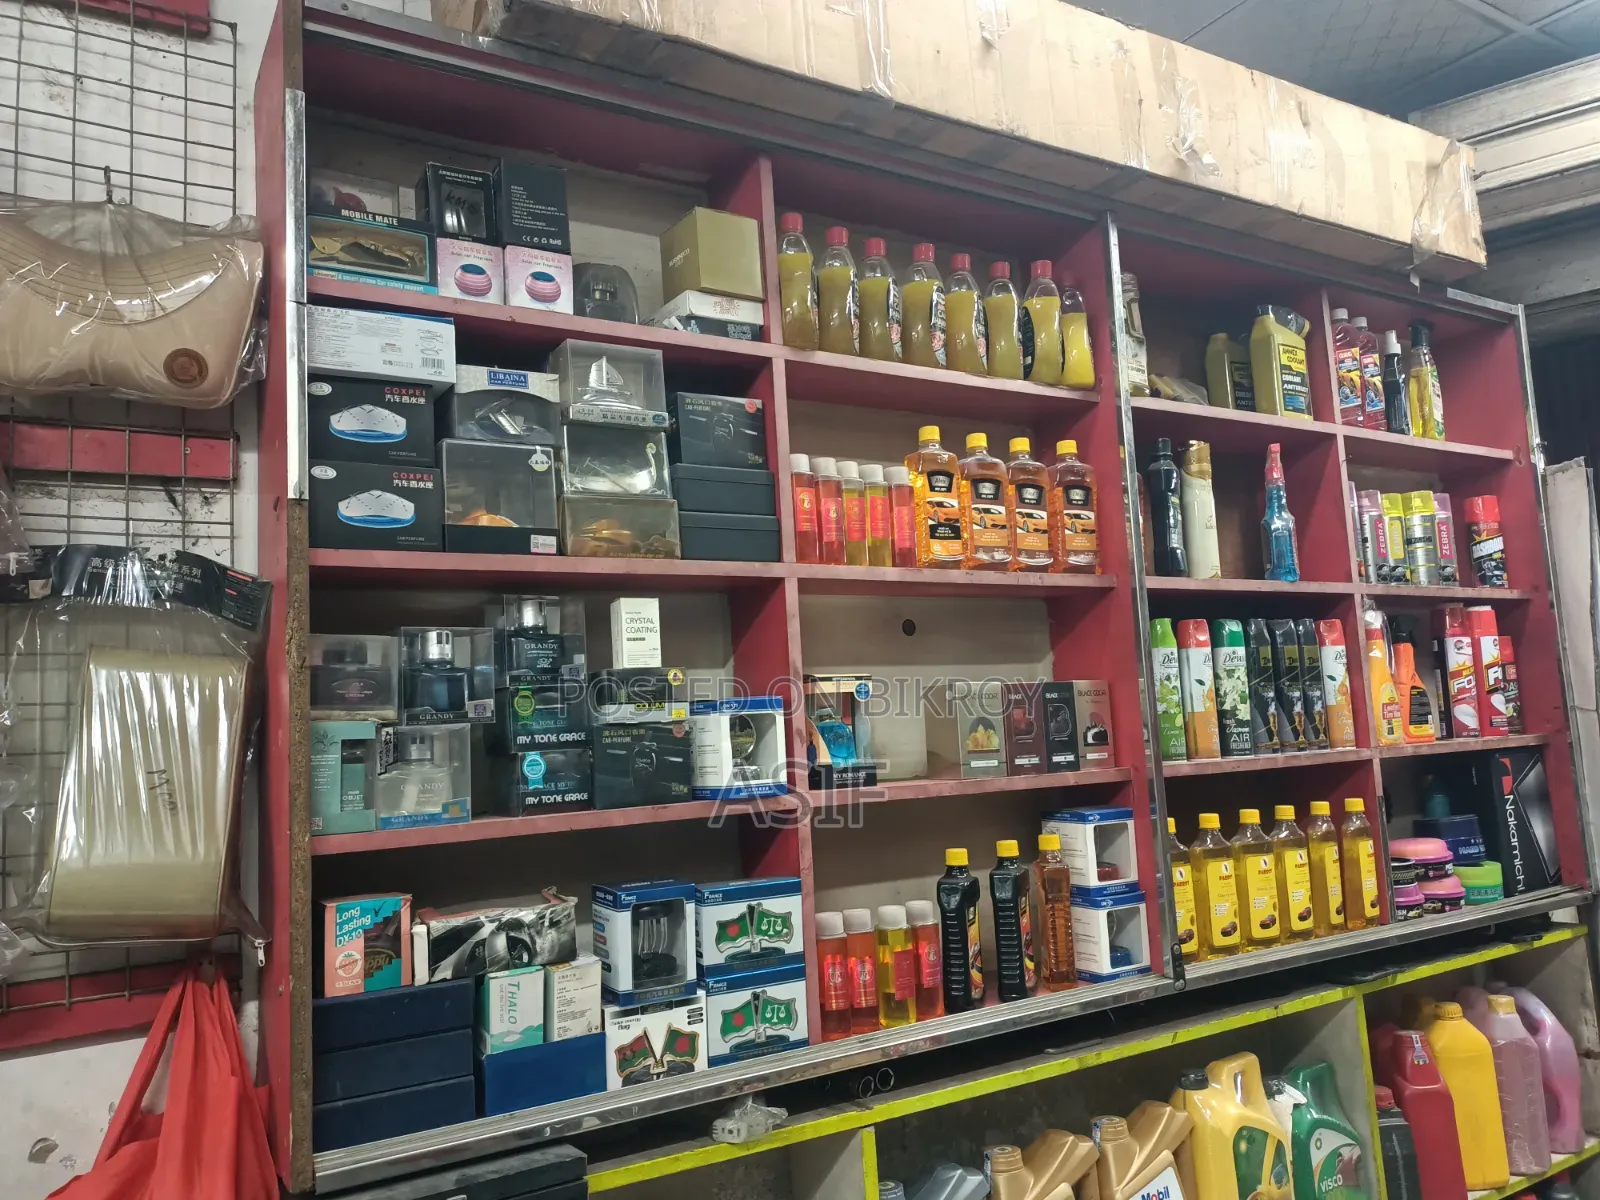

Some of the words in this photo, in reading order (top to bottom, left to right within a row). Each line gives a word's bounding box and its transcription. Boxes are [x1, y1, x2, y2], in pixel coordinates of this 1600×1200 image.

[342, 209, 374, 221] MOBILE
[376, 215, 398, 226] MATE
[385, 387, 426, 396] COXPEI
[393, 472, 433, 480] COXPEI
[1441, 525, 1449, 555] ZEBRA
[517, 736, 531, 744] MY
[534, 734, 557, 743] TONE
[559, 732, 586, 741] GRACE
[1230, 734, 1250, 742] AIR
[541, 795, 563, 803] TONE
[564, 793, 588, 801] GRACE
[392, 814, 429, 823] GRANDY
[1504, 794, 1525, 891] Nakamichi
[336, 906, 360, 922] Long
[336, 915, 371, 935] Lasting
[336, 929, 363, 947] DX-10
[508, 981, 520, 1024] THALO
[1320, 1174, 1343, 1193] visco
[1141, 1185, 1170, 1200] Mobil
